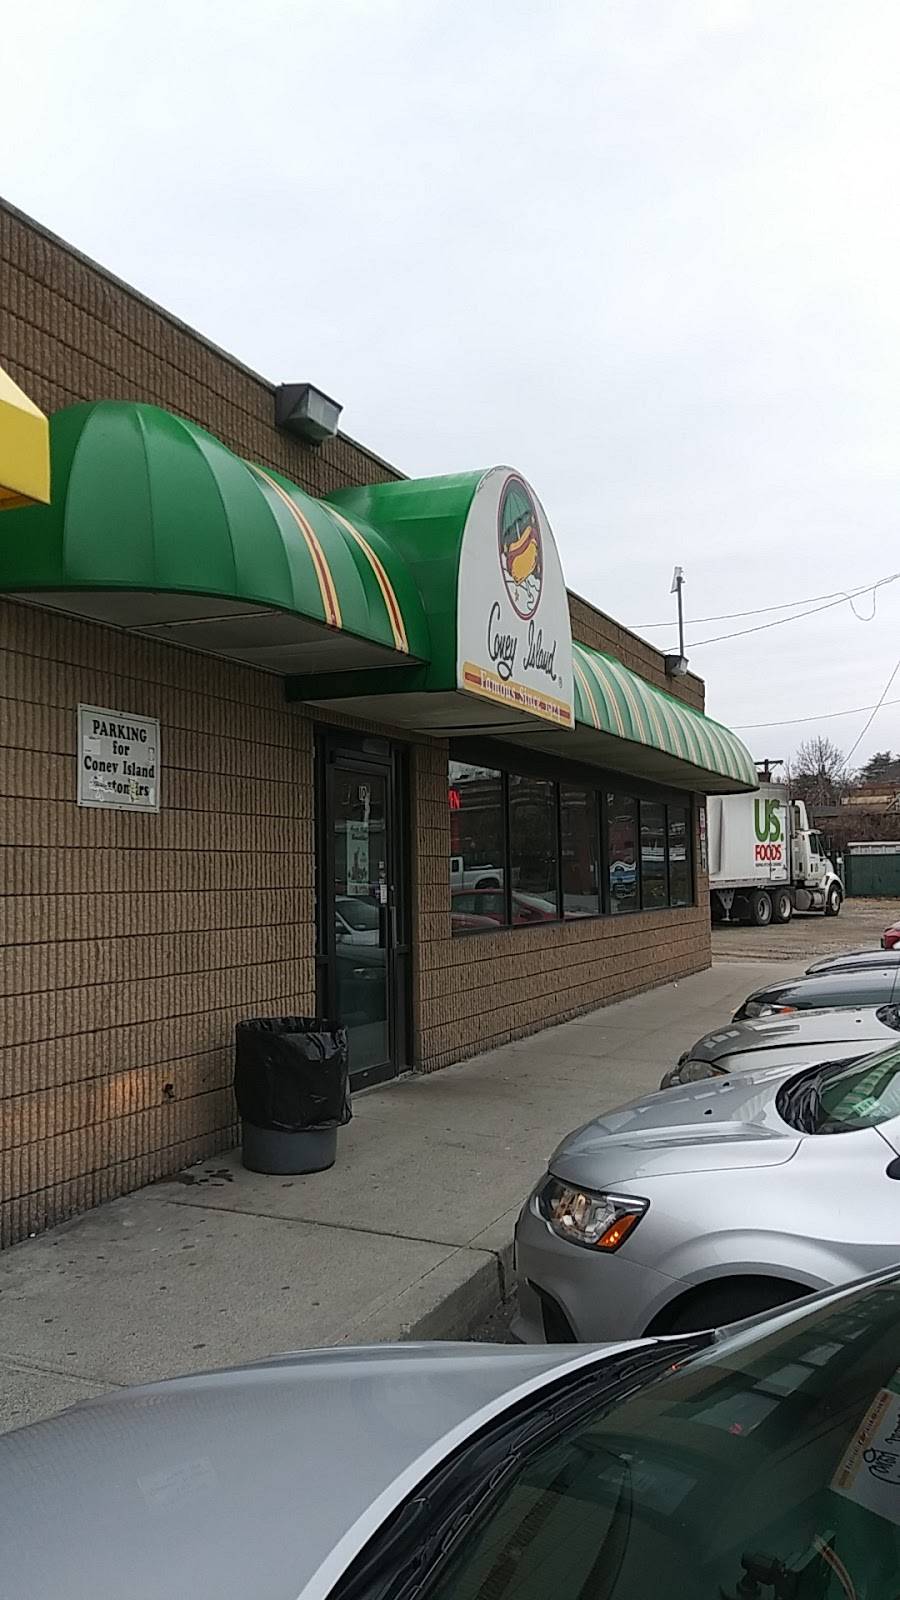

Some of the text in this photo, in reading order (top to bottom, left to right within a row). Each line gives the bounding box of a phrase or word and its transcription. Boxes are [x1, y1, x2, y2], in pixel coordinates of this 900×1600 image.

[487, 601, 557, 681] Coney Island
[92, 719, 147, 743] PARKING
[112, 740, 130, 756] for
[84, 755, 155, 778] Coney Island
[755, 844, 782, 861] FOODS
